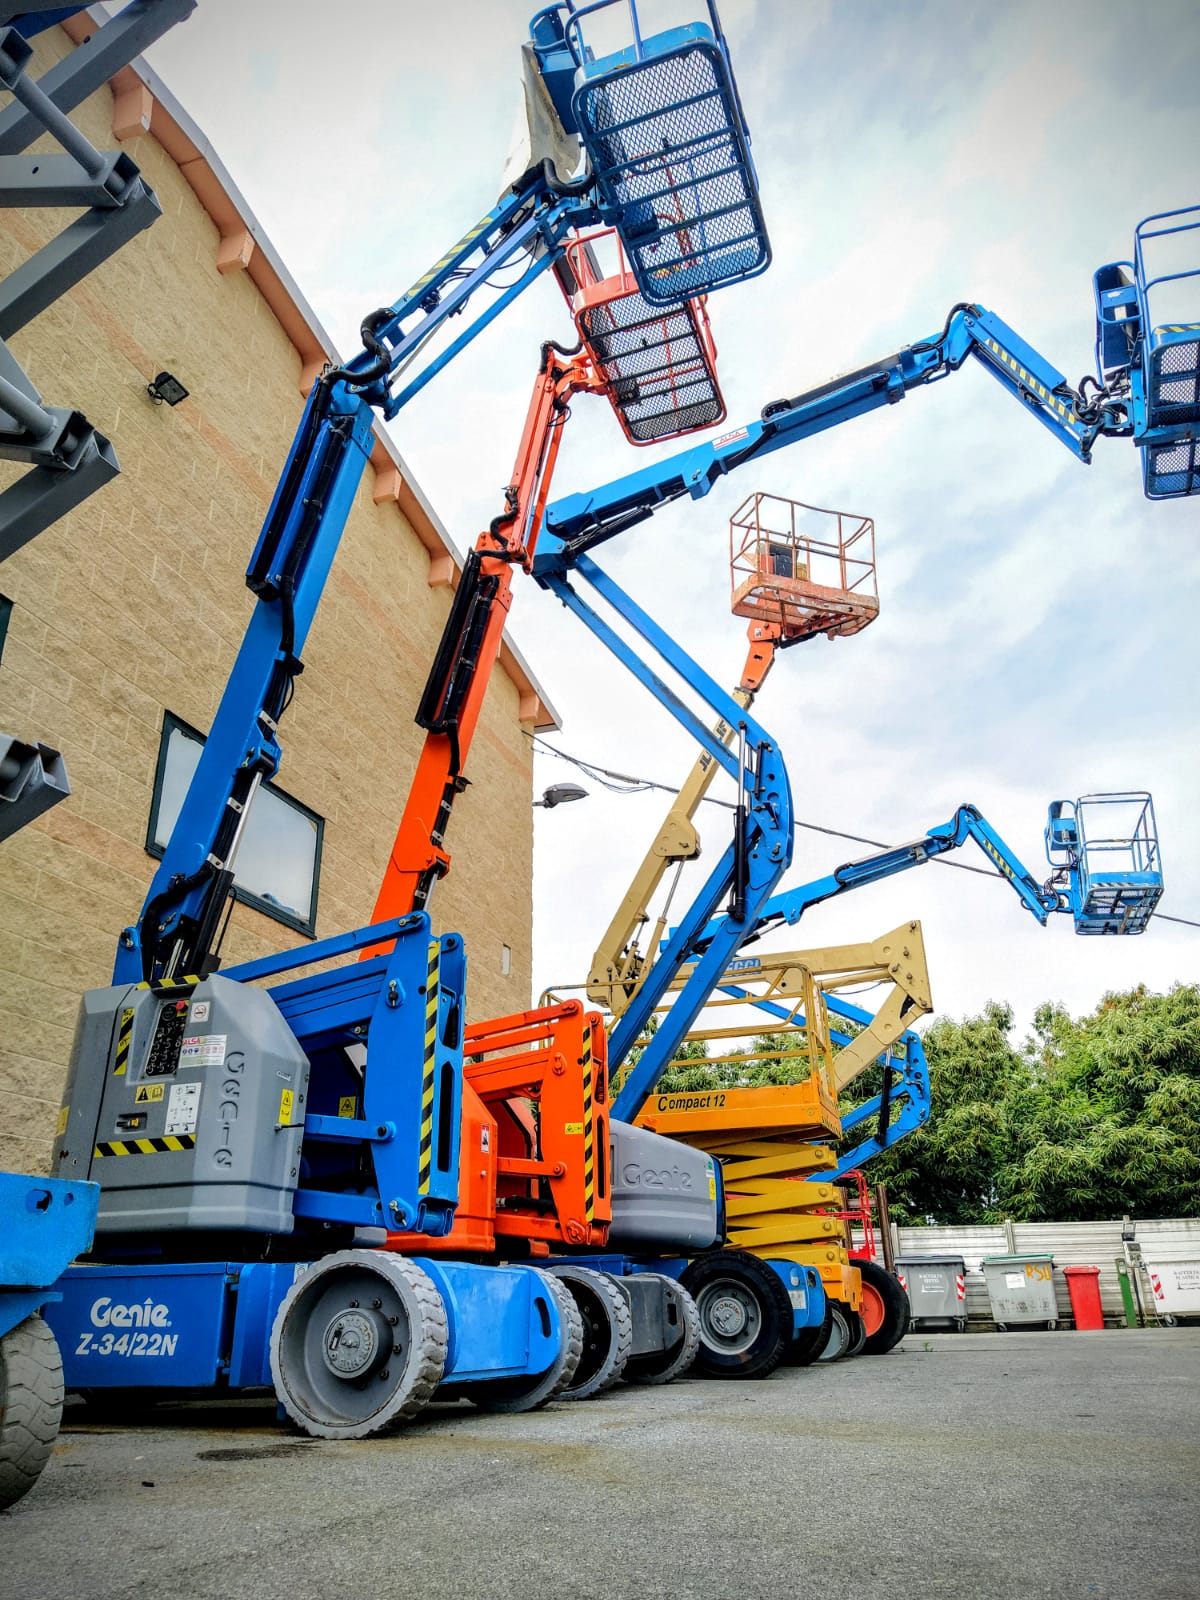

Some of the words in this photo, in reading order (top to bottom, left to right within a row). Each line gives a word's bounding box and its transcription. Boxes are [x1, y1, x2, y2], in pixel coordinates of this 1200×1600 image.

[213, 1051, 245, 1171] Genie
[657, 1096, 711, 1112] Compact
[713, 1094, 726, 1107] 12
[623, 1163, 693, 1188] Genie
[90, 1297, 170, 1328] Genie
[75, 1332, 179, 1357] Z-34/22N
